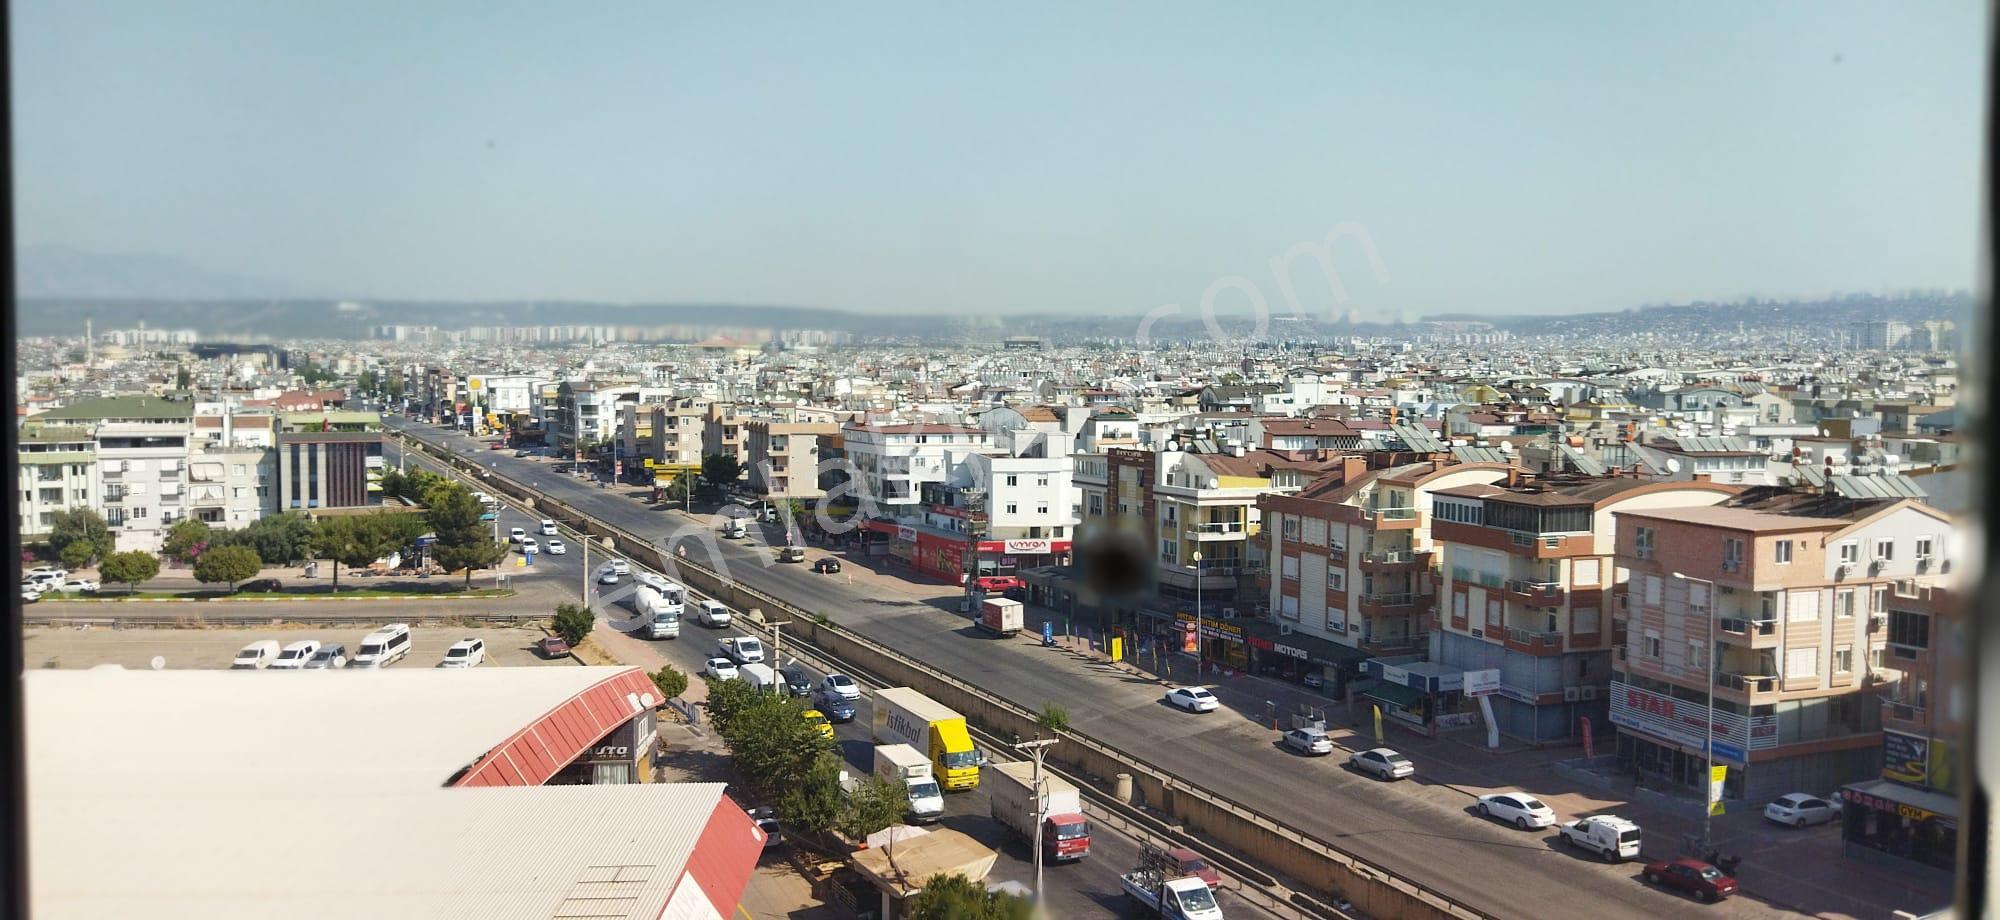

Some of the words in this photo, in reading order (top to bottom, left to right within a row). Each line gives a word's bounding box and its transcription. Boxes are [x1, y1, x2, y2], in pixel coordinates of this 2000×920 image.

[1273, 643, 1308, 659] MOTORS
[1627, 690, 1676, 718] STAR
[1900, 805, 1923, 818] GYM
